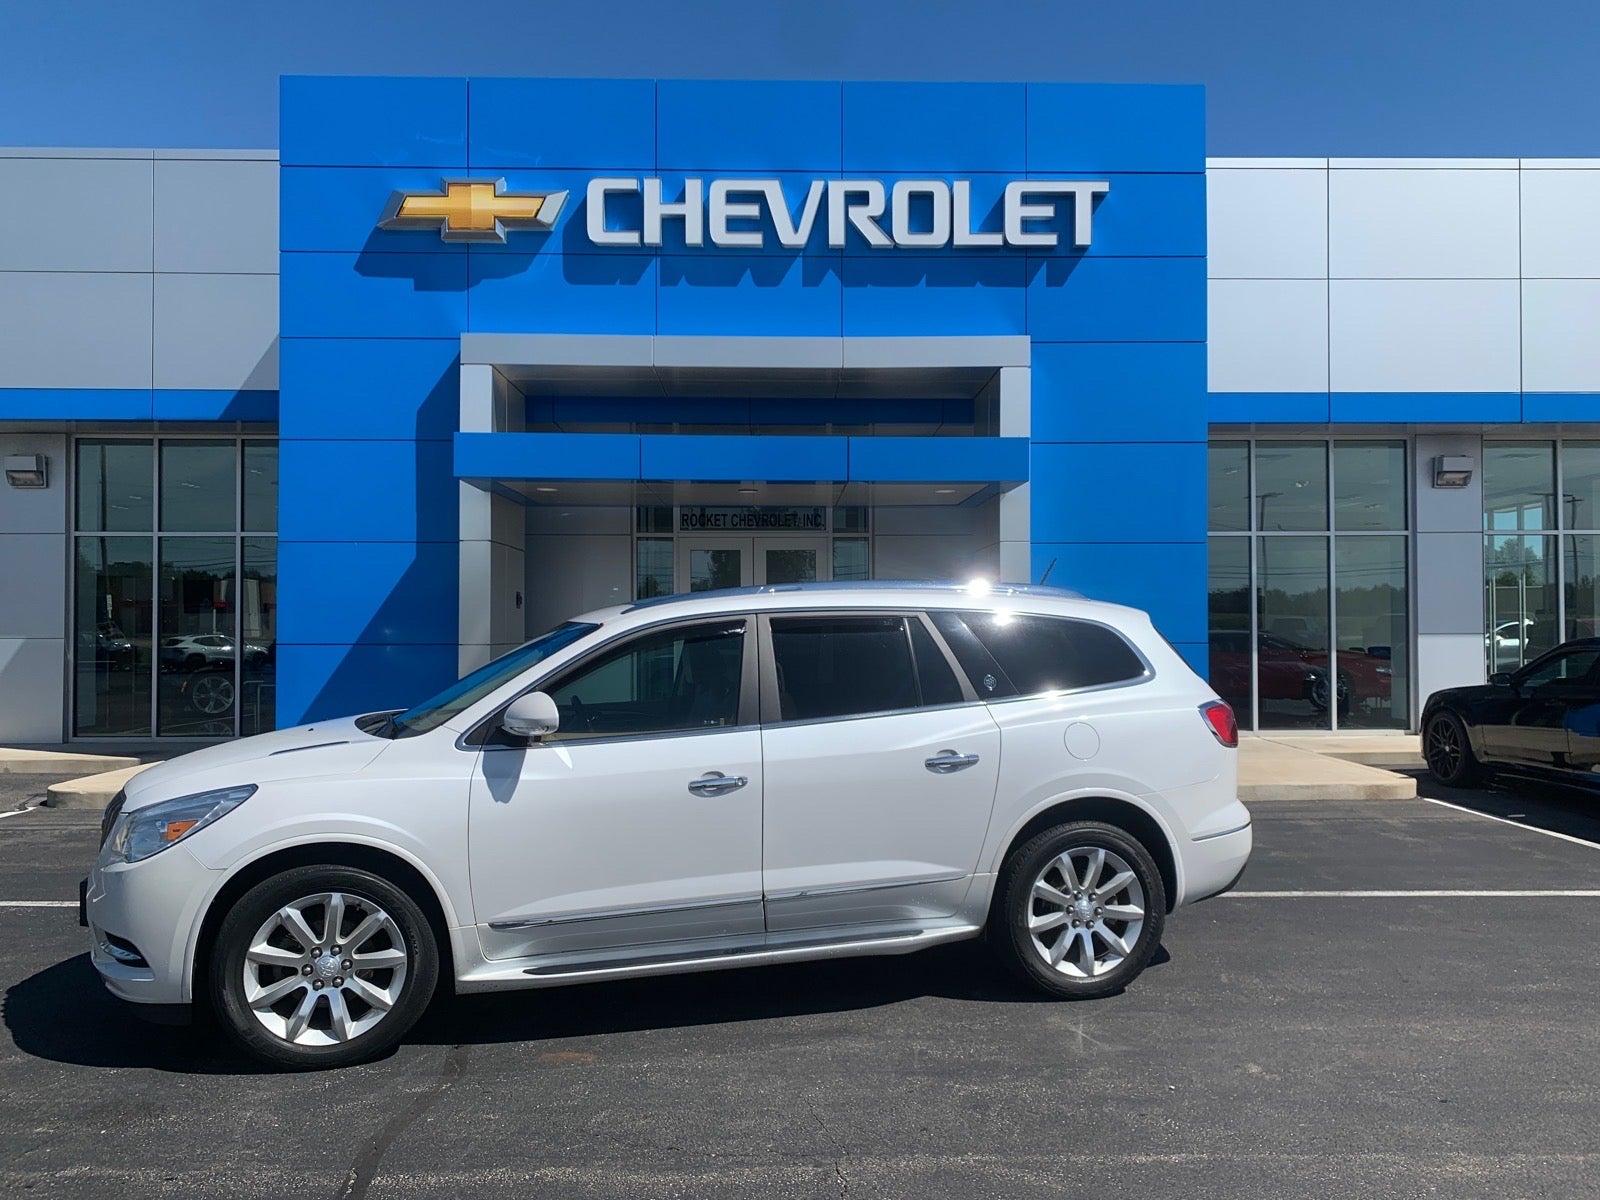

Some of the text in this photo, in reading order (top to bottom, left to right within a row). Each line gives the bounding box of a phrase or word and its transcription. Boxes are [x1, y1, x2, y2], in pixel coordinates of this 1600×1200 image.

[587, 178, 1109, 248] CHEVROLET
[681, 513, 728, 527] ROCKET
[803, 513, 825, 527] INC.
